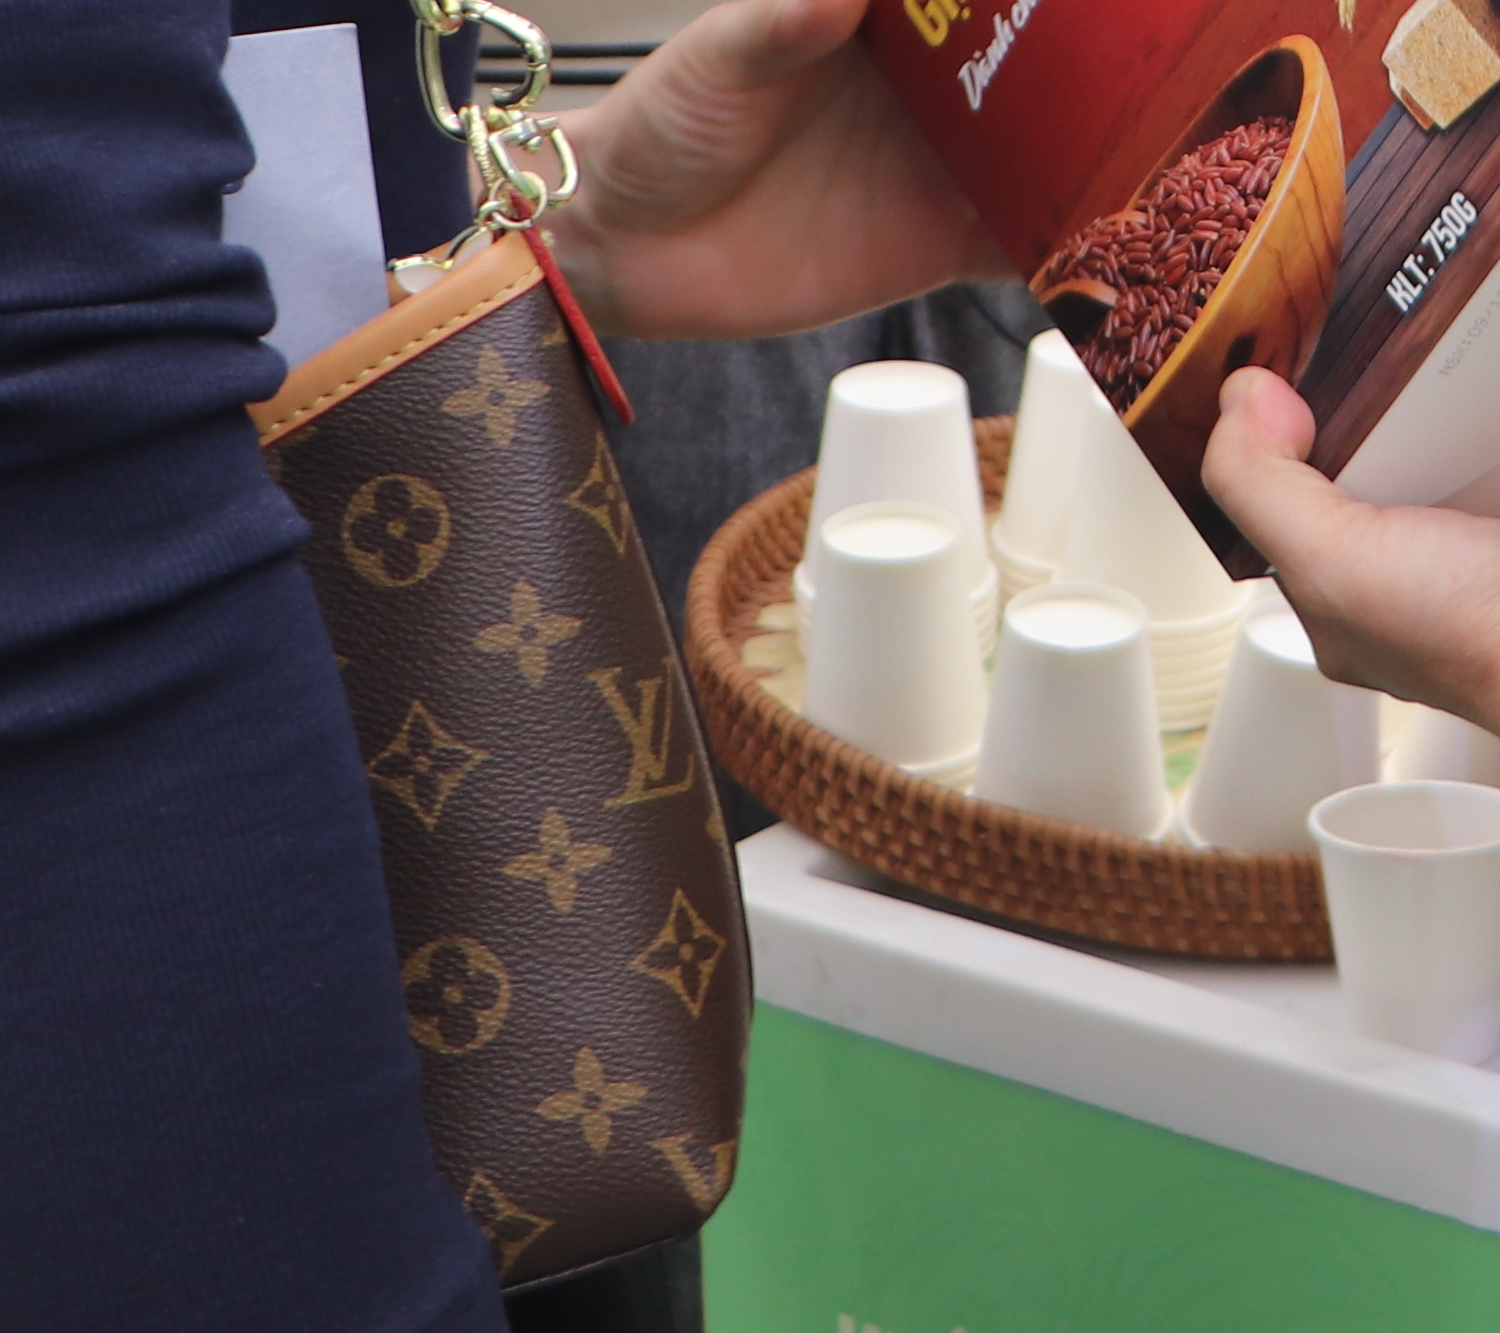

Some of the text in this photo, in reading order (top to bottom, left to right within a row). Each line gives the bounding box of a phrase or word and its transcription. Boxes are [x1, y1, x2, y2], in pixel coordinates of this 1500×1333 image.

[957, 12, 1015, 111] Dành
[1386, 191, 1478, 312] KLT: 750G
